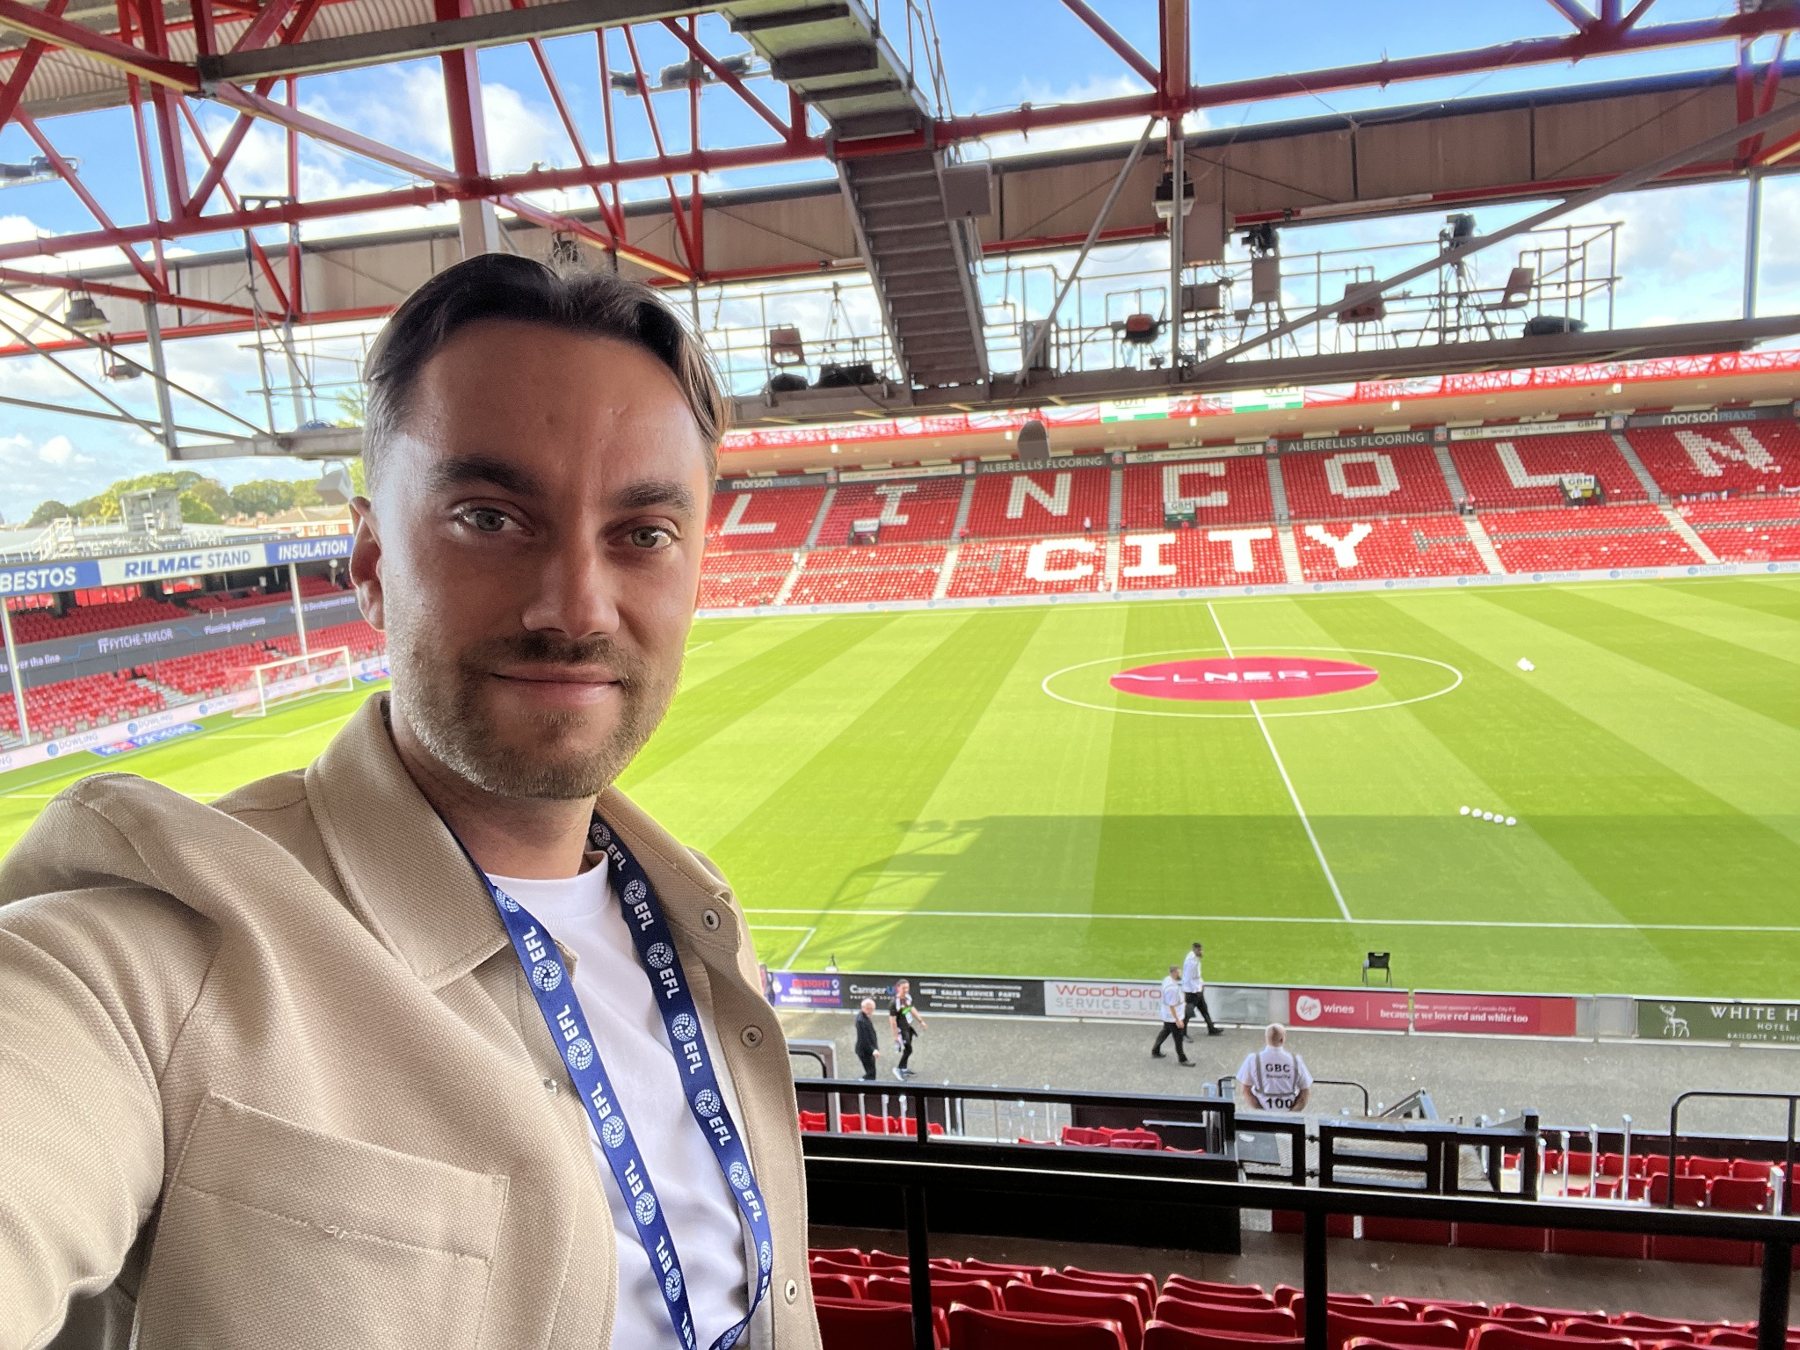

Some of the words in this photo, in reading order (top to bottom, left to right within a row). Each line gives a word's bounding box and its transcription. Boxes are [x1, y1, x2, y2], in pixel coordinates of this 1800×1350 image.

[1577, 420, 1599, 428] GBM
[1662, 411, 1718, 426] morson
[1288, 437, 1357, 452] ALBERELLIS
[1361, 432, 1425, 447] FLOORING
[982, 459, 1044, 473] ALBERELLIS
[1046, 456, 1103, 470] FLOORING
[732, 477, 773, 489] morson
[1568, 477, 1593, 486] GBM
[1171, 501, 1192, 511] GBM
[278, 541, 348, 561] INSULATION
[1025, 523, 1373, 582] CITY
[124, 556, 202, 579] RILMAC
[207, 550, 251, 568] STAND
[0, 566, 77, 593] BESTOS
[1173, 670, 1311, 684] LNER
[58, 734, 99, 750] DOWLING
[607, 843, 627, 872] EFL
[634, 901, 655, 932] EFL
[523, 925, 547, 963] EFL
[659, 967, 680, 1000] EFL
[849, 984, 896, 996] CamperU
[1056, 984, 1162, 999] Woodboro
[1056, 998, 1131, 1010] SERVICES
[1324, 1003, 1355, 1014] wines
[1421, 1012, 1433, 1020] we
[1434, 1011, 1453, 1021] love
[1453, 1011, 1469, 1021] red
[1470, 1012, 1486, 1022] and
[1487, 1013, 1512, 1023] white
[1513, 1014, 1529, 1023] too
[1711, 1006, 1776, 1020] WHITE
[556, 1004, 580, 1042] EFL
[1757, 1023, 1790, 1032] HOTEL
[683, 1040, 703, 1075] EFL
[1265, 1063, 1291, 1073] GBC
[591, 1082, 612, 1120] EFL
[1266, 1098, 1293, 1109] 100
[709, 1116, 732, 1147] EFL
[624, 1158, 645, 1198] EFL
[742, 1190, 763, 1223] EFL
[655, 1235, 673, 1274] EFL
